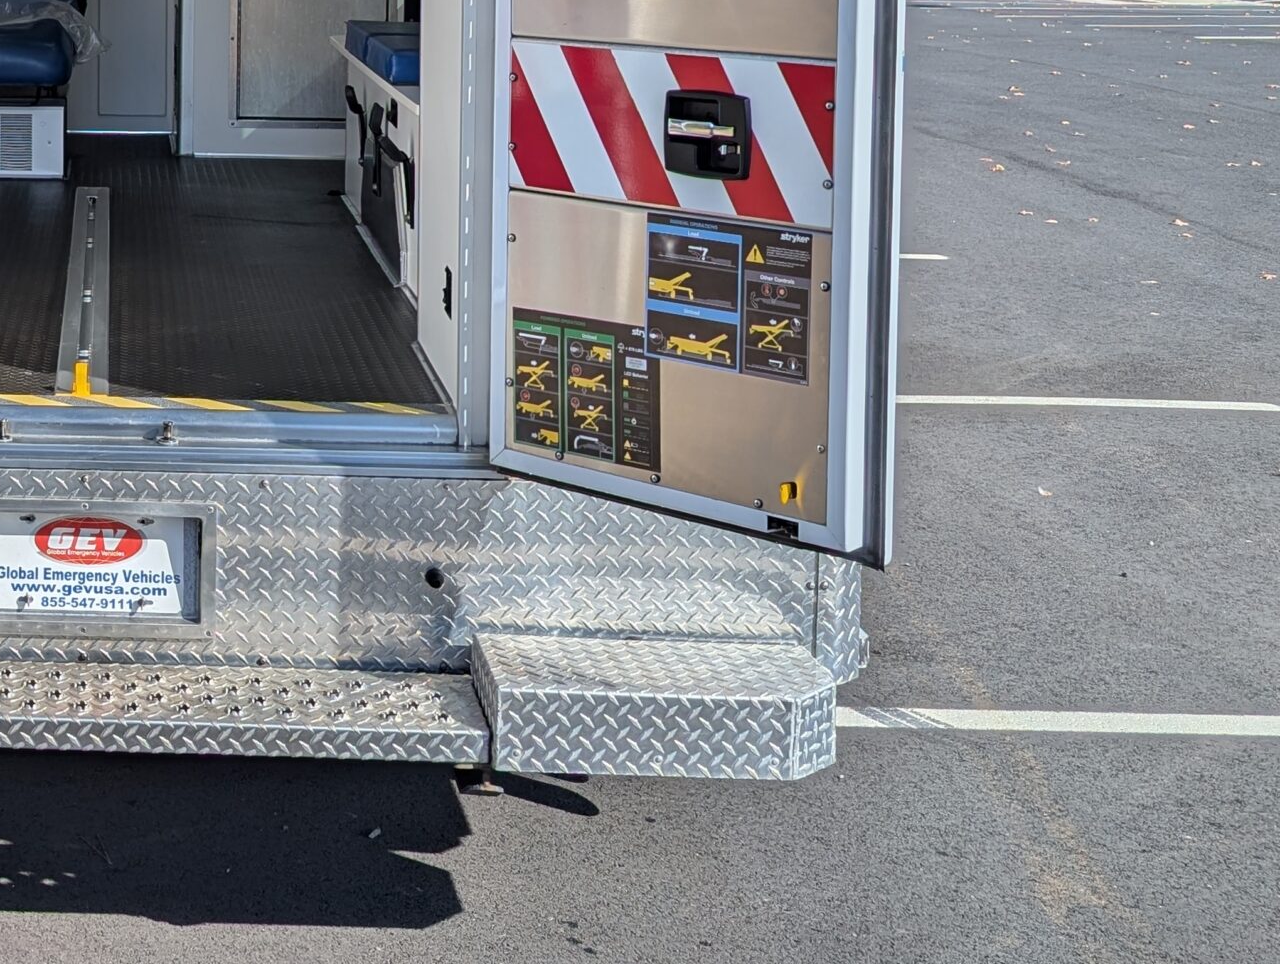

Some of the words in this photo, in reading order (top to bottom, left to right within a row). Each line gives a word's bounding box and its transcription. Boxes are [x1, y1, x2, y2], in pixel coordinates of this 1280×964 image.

[780, 232, 810, 243] stryker
[774, 277, 795, 285] Controls
[47, 526, 128, 551] GEV
[47, 548, 67, 556] Global
[67, 549, 100, 557] Emergency
[43, 567, 119, 585] Emergency
[122, 569, 181, 585] Vehicles
[10, 583, 168, 597] www.gevusa.com
[40, 596, 133, 610] 855-547-9111
